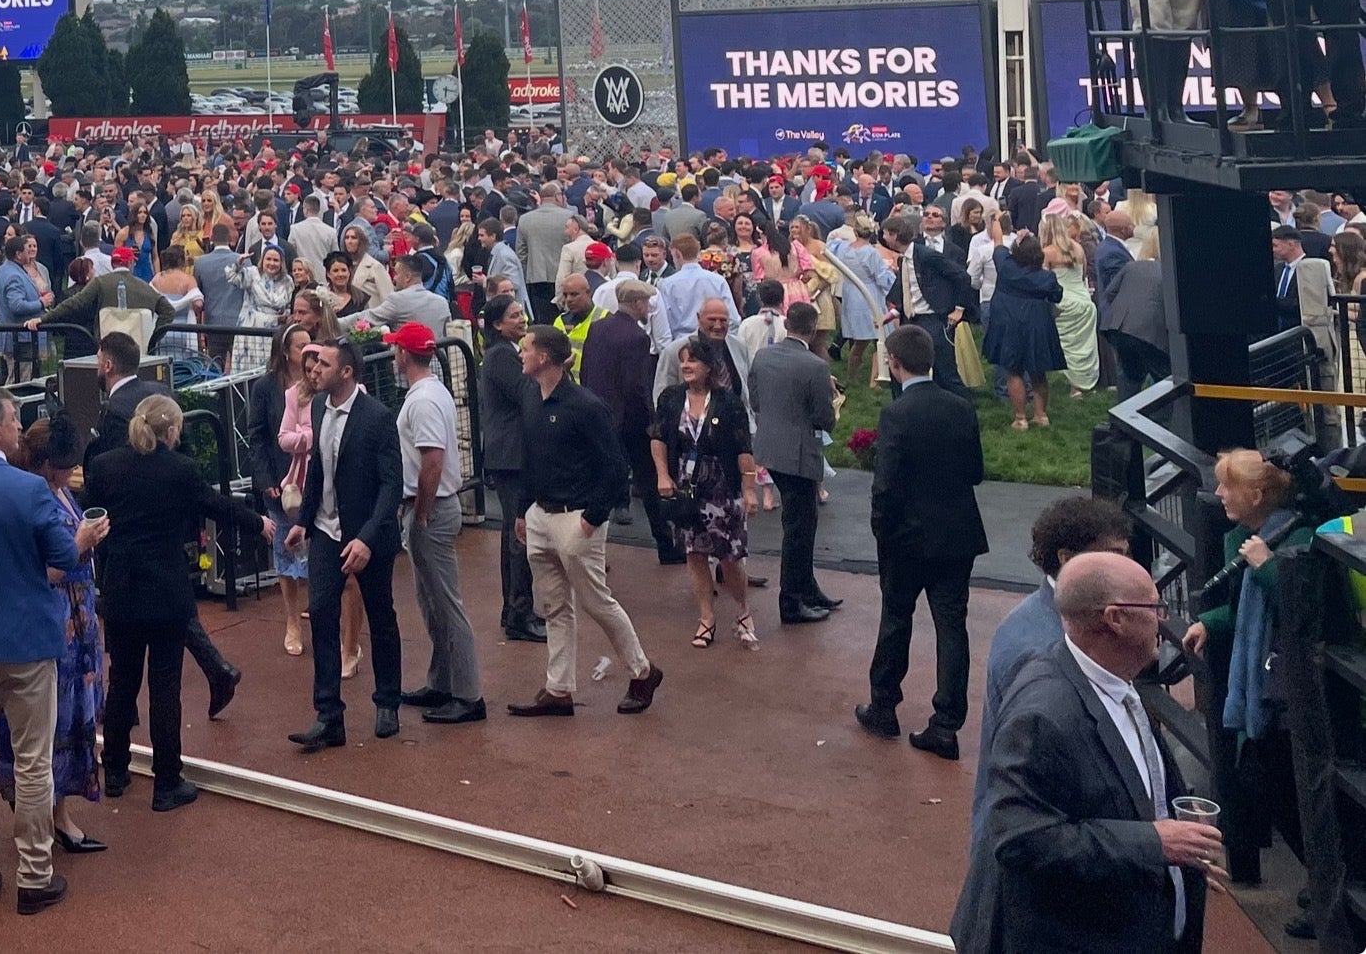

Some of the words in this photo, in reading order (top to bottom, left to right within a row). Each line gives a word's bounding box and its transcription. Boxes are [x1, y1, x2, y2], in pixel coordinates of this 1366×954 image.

[725, 48, 862, 77] THANKS
[868, 47, 937, 75] FOR
[508, 82, 561, 98] adbroke
[710, 83, 771, 109] THE
[777, 80, 960, 109] MEMORIES
[74, 120, 162, 141] Ladbrokes
[785, 130, 800, 139] The
[800, 130, 825, 141] Valley
